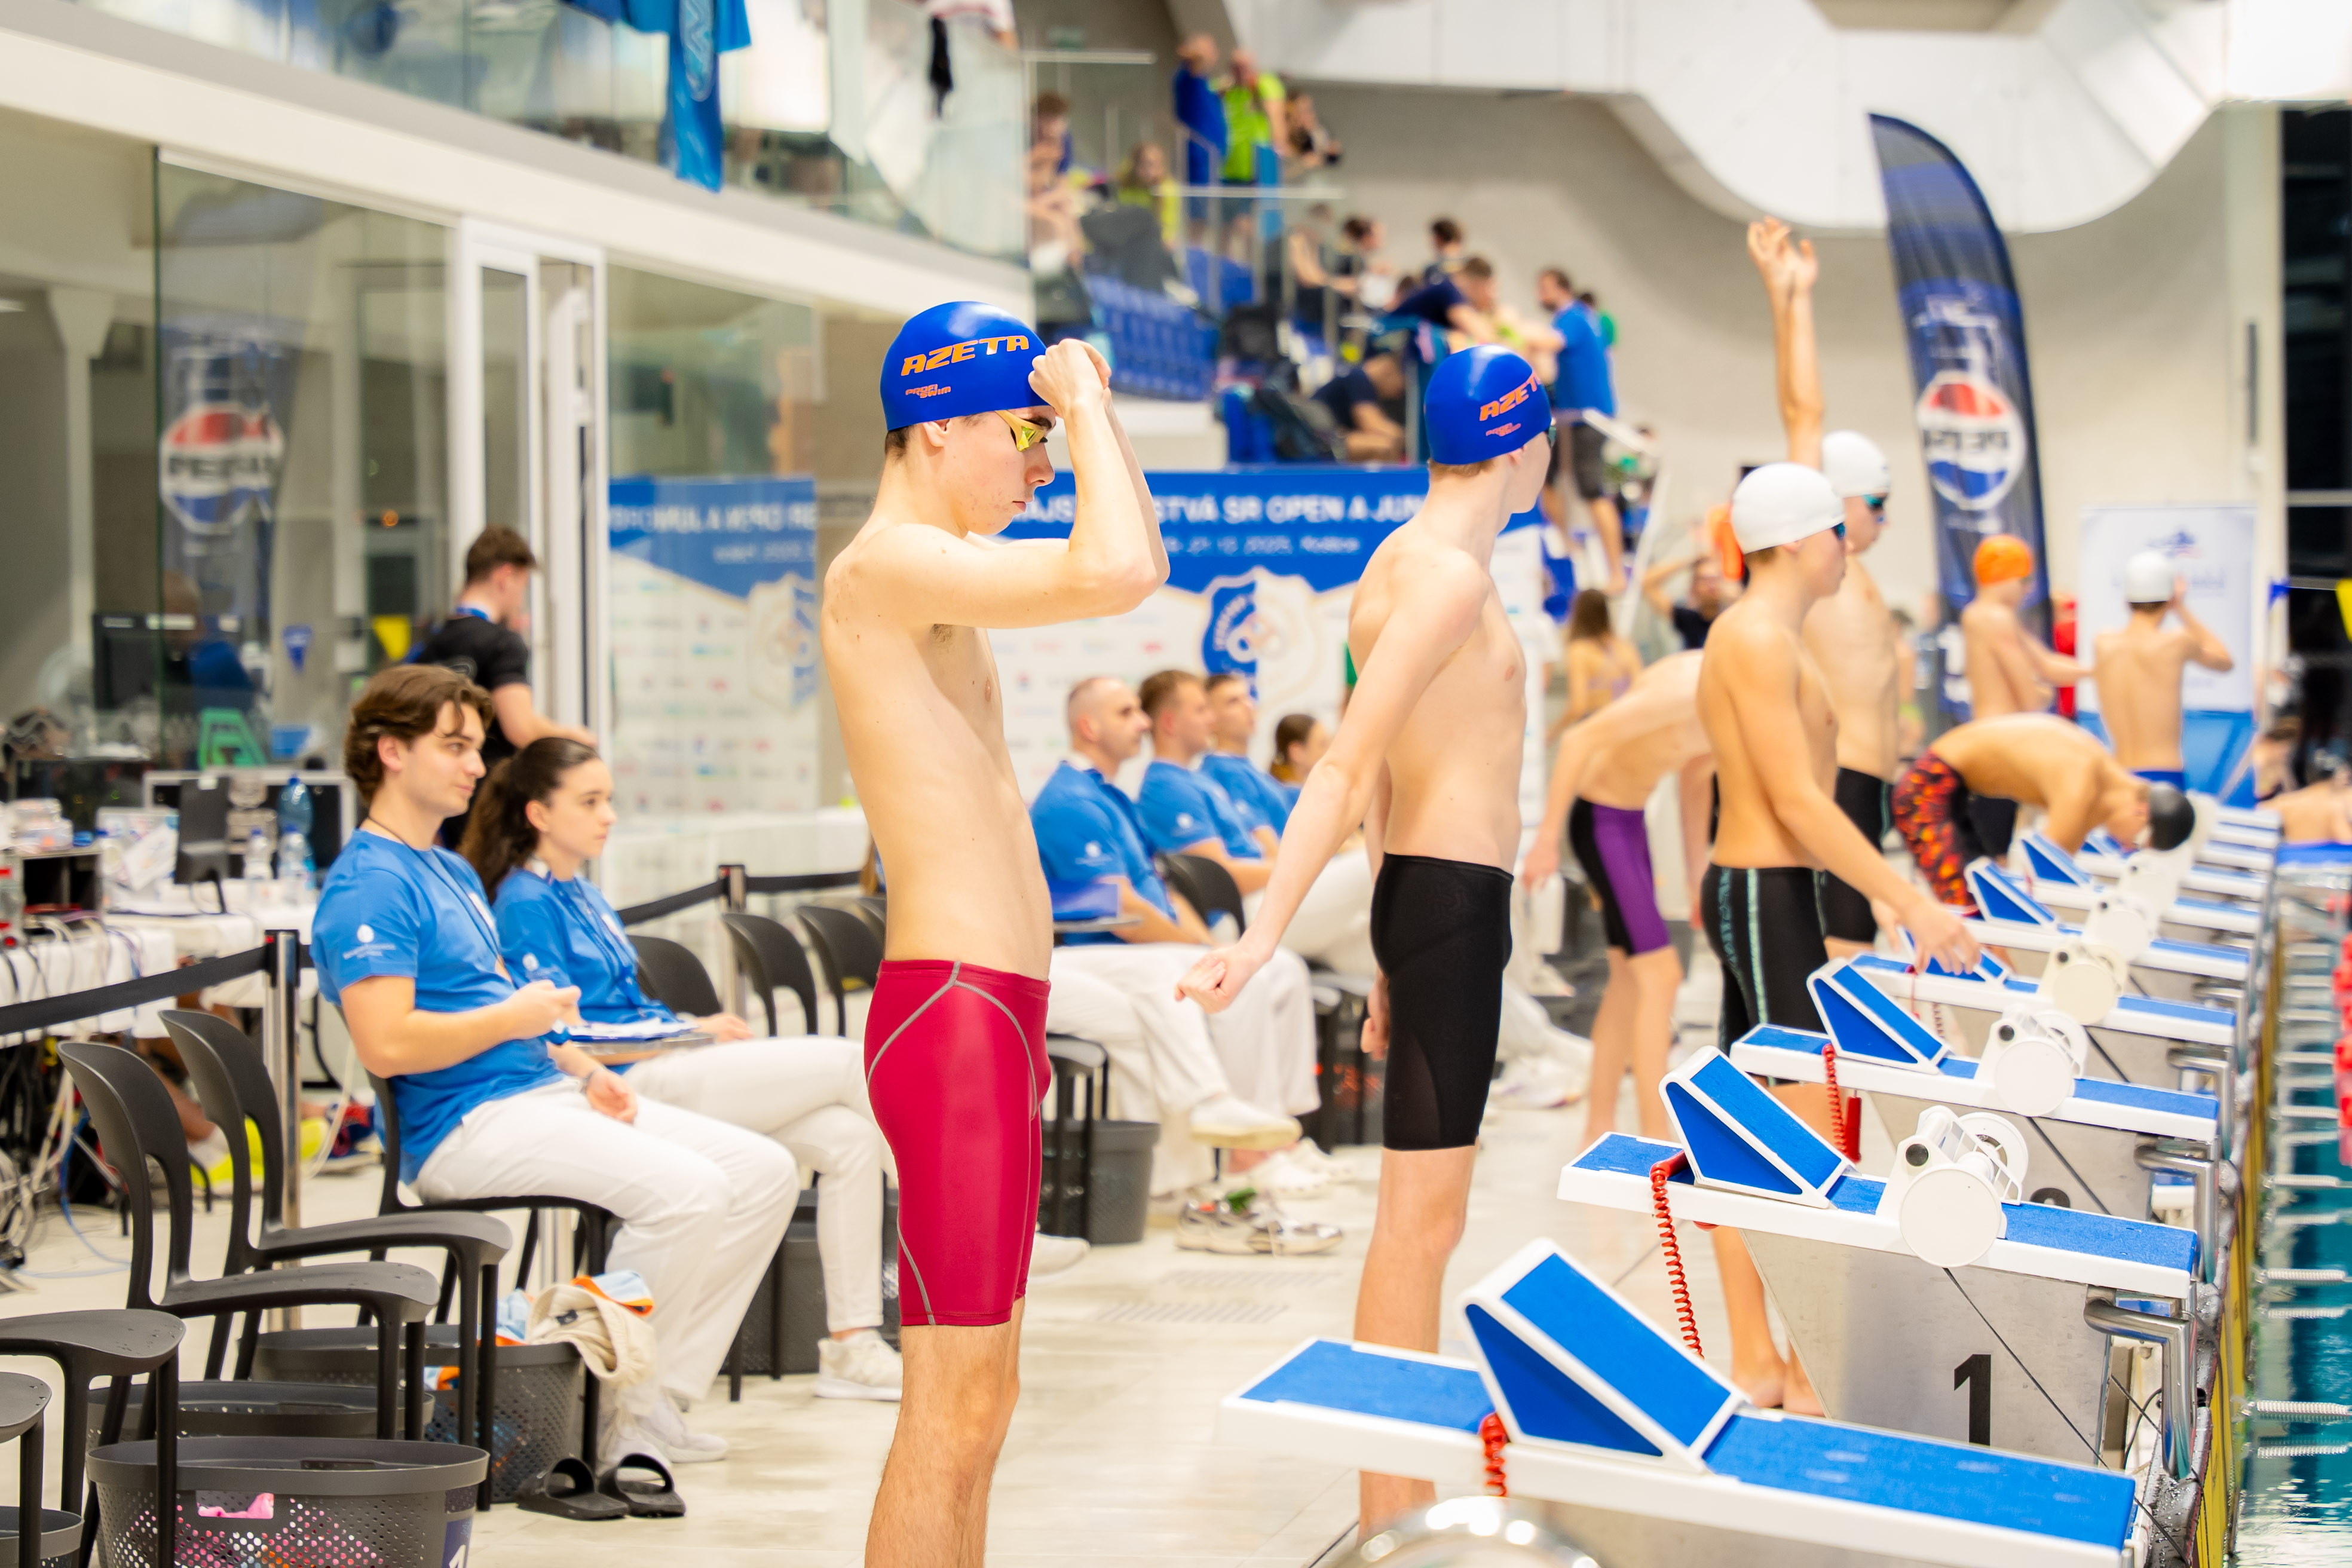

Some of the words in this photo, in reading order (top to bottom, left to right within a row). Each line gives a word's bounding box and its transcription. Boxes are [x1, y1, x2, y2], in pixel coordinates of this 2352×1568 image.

[901, 335, 1029, 376] AZETA
[1480, 369, 1541, 421] AZET
[1266, 494, 1345, 524] OPEN
[1348, 495, 1369, 522] A
[1954, 1354, 1991, 1446] 1
